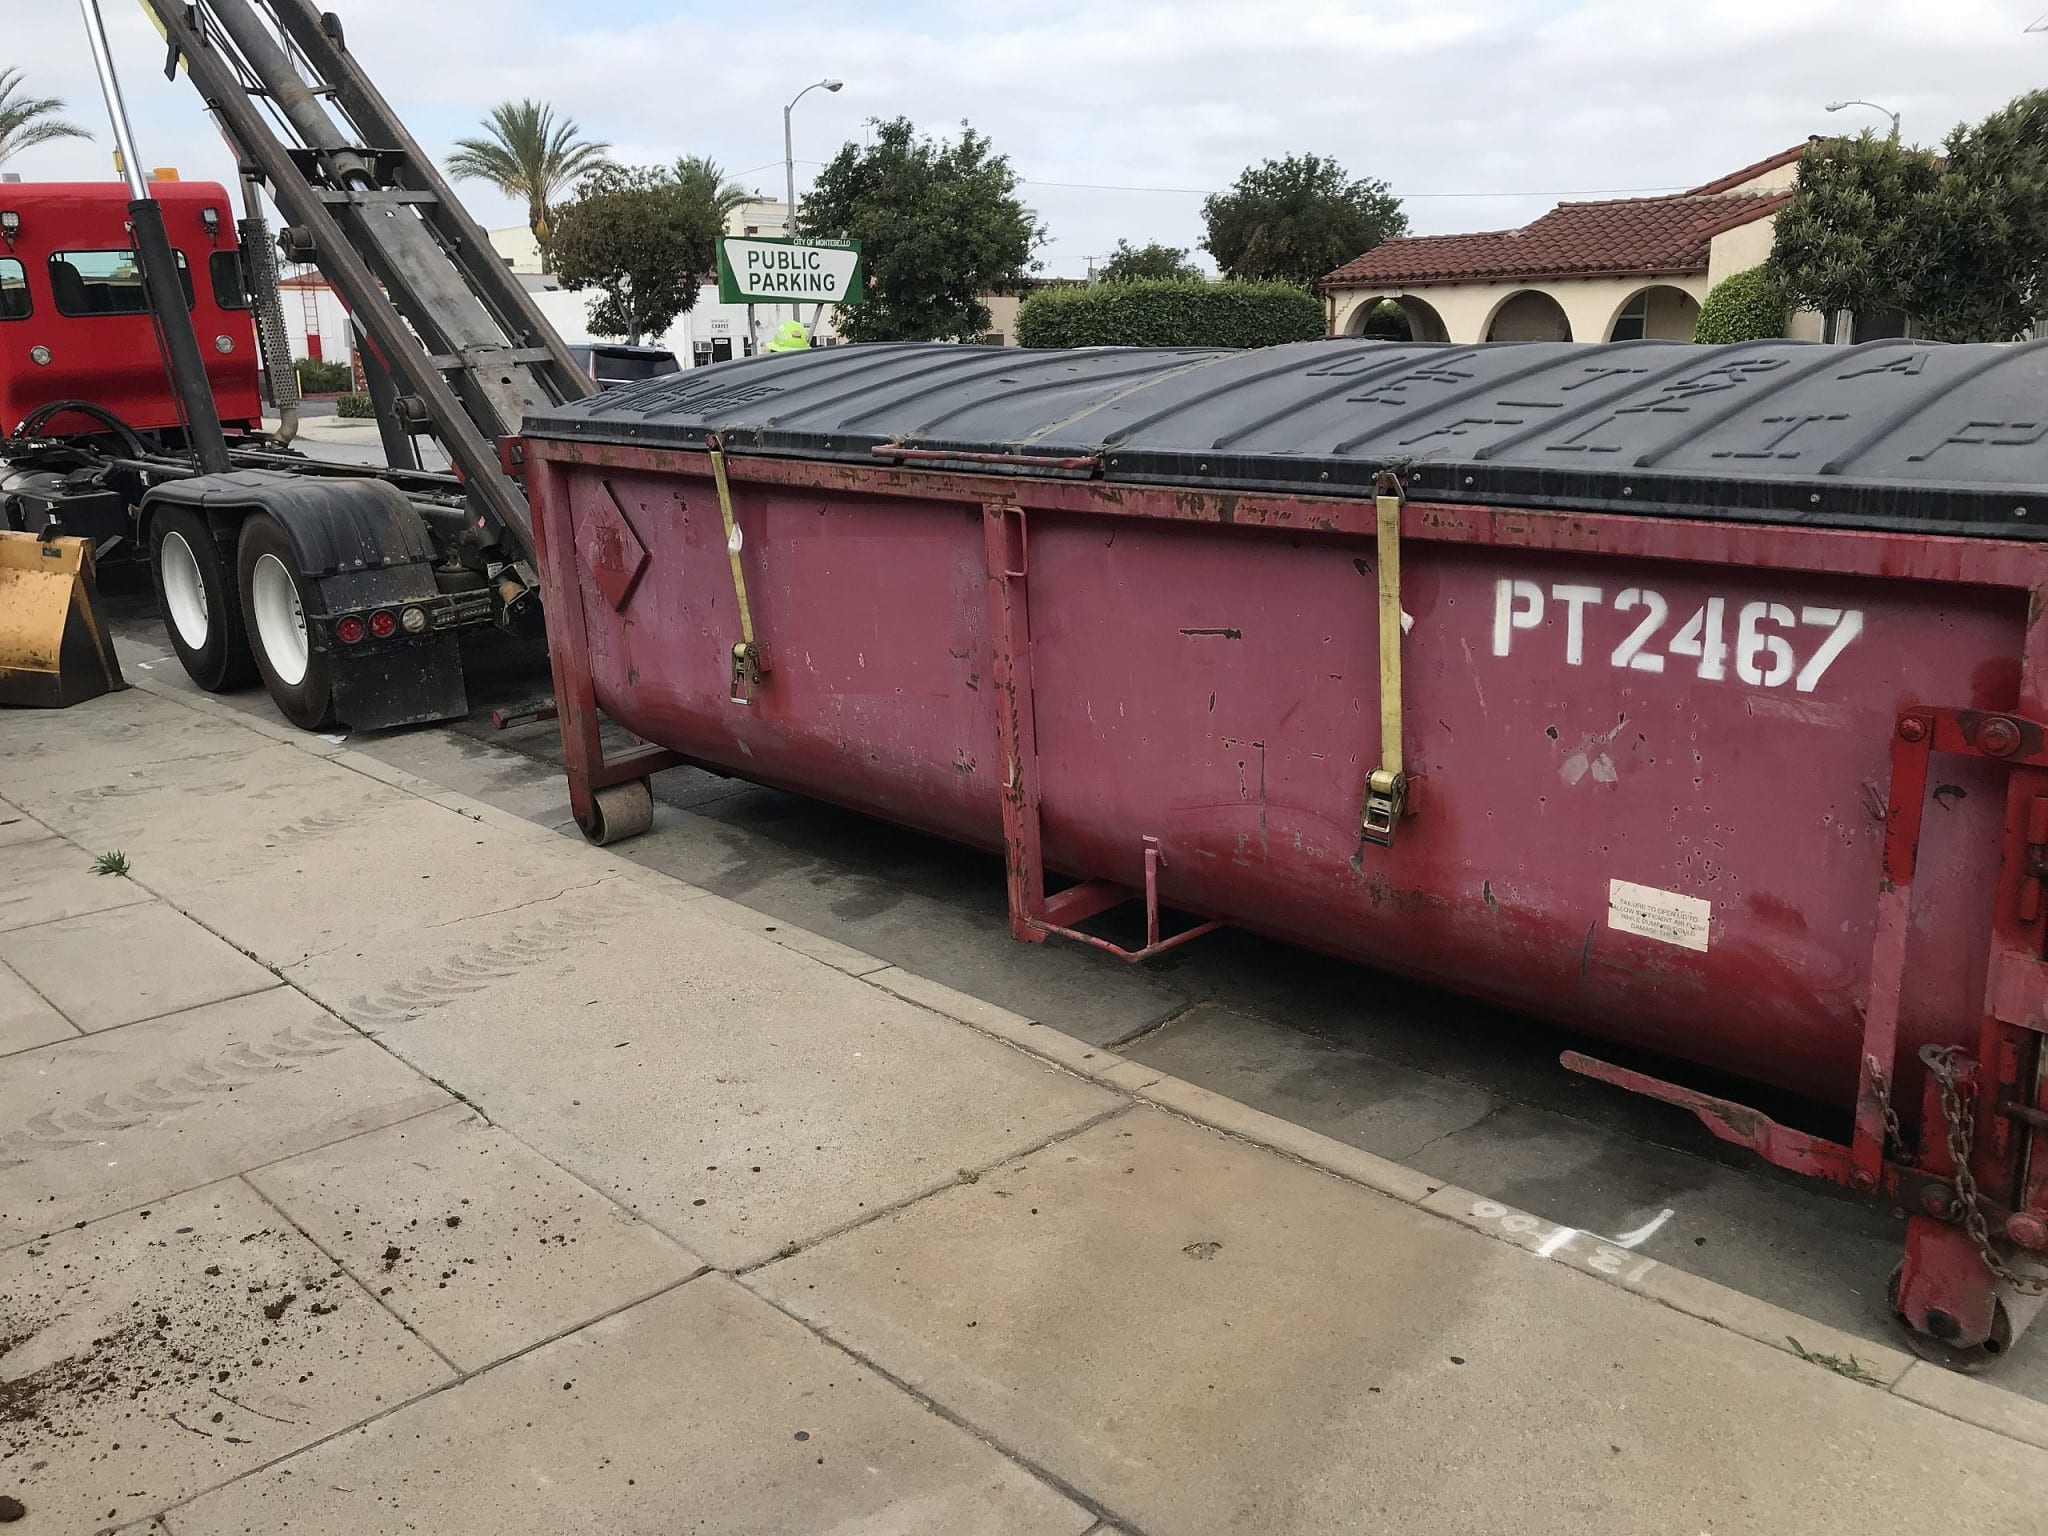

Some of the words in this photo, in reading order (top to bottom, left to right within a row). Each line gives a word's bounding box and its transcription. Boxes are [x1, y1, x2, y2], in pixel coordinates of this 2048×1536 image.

[793, 238, 806, 246] CITY
[815, 239, 851, 248] MONTEBELLO
[748, 250, 820, 270] PUBLIC
[749, 273, 835, 292] PARKING
[1492, 579, 1865, 692] PT2467
[1612, 904, 1635, 915] ALLOW
[1620, 899, 1644, 910] FAILURE
[1657, 908, 1676, 917] OPEN
[1688, 915, 1698, 923] TO
[1621, 913, 1641, 923] WHILE
